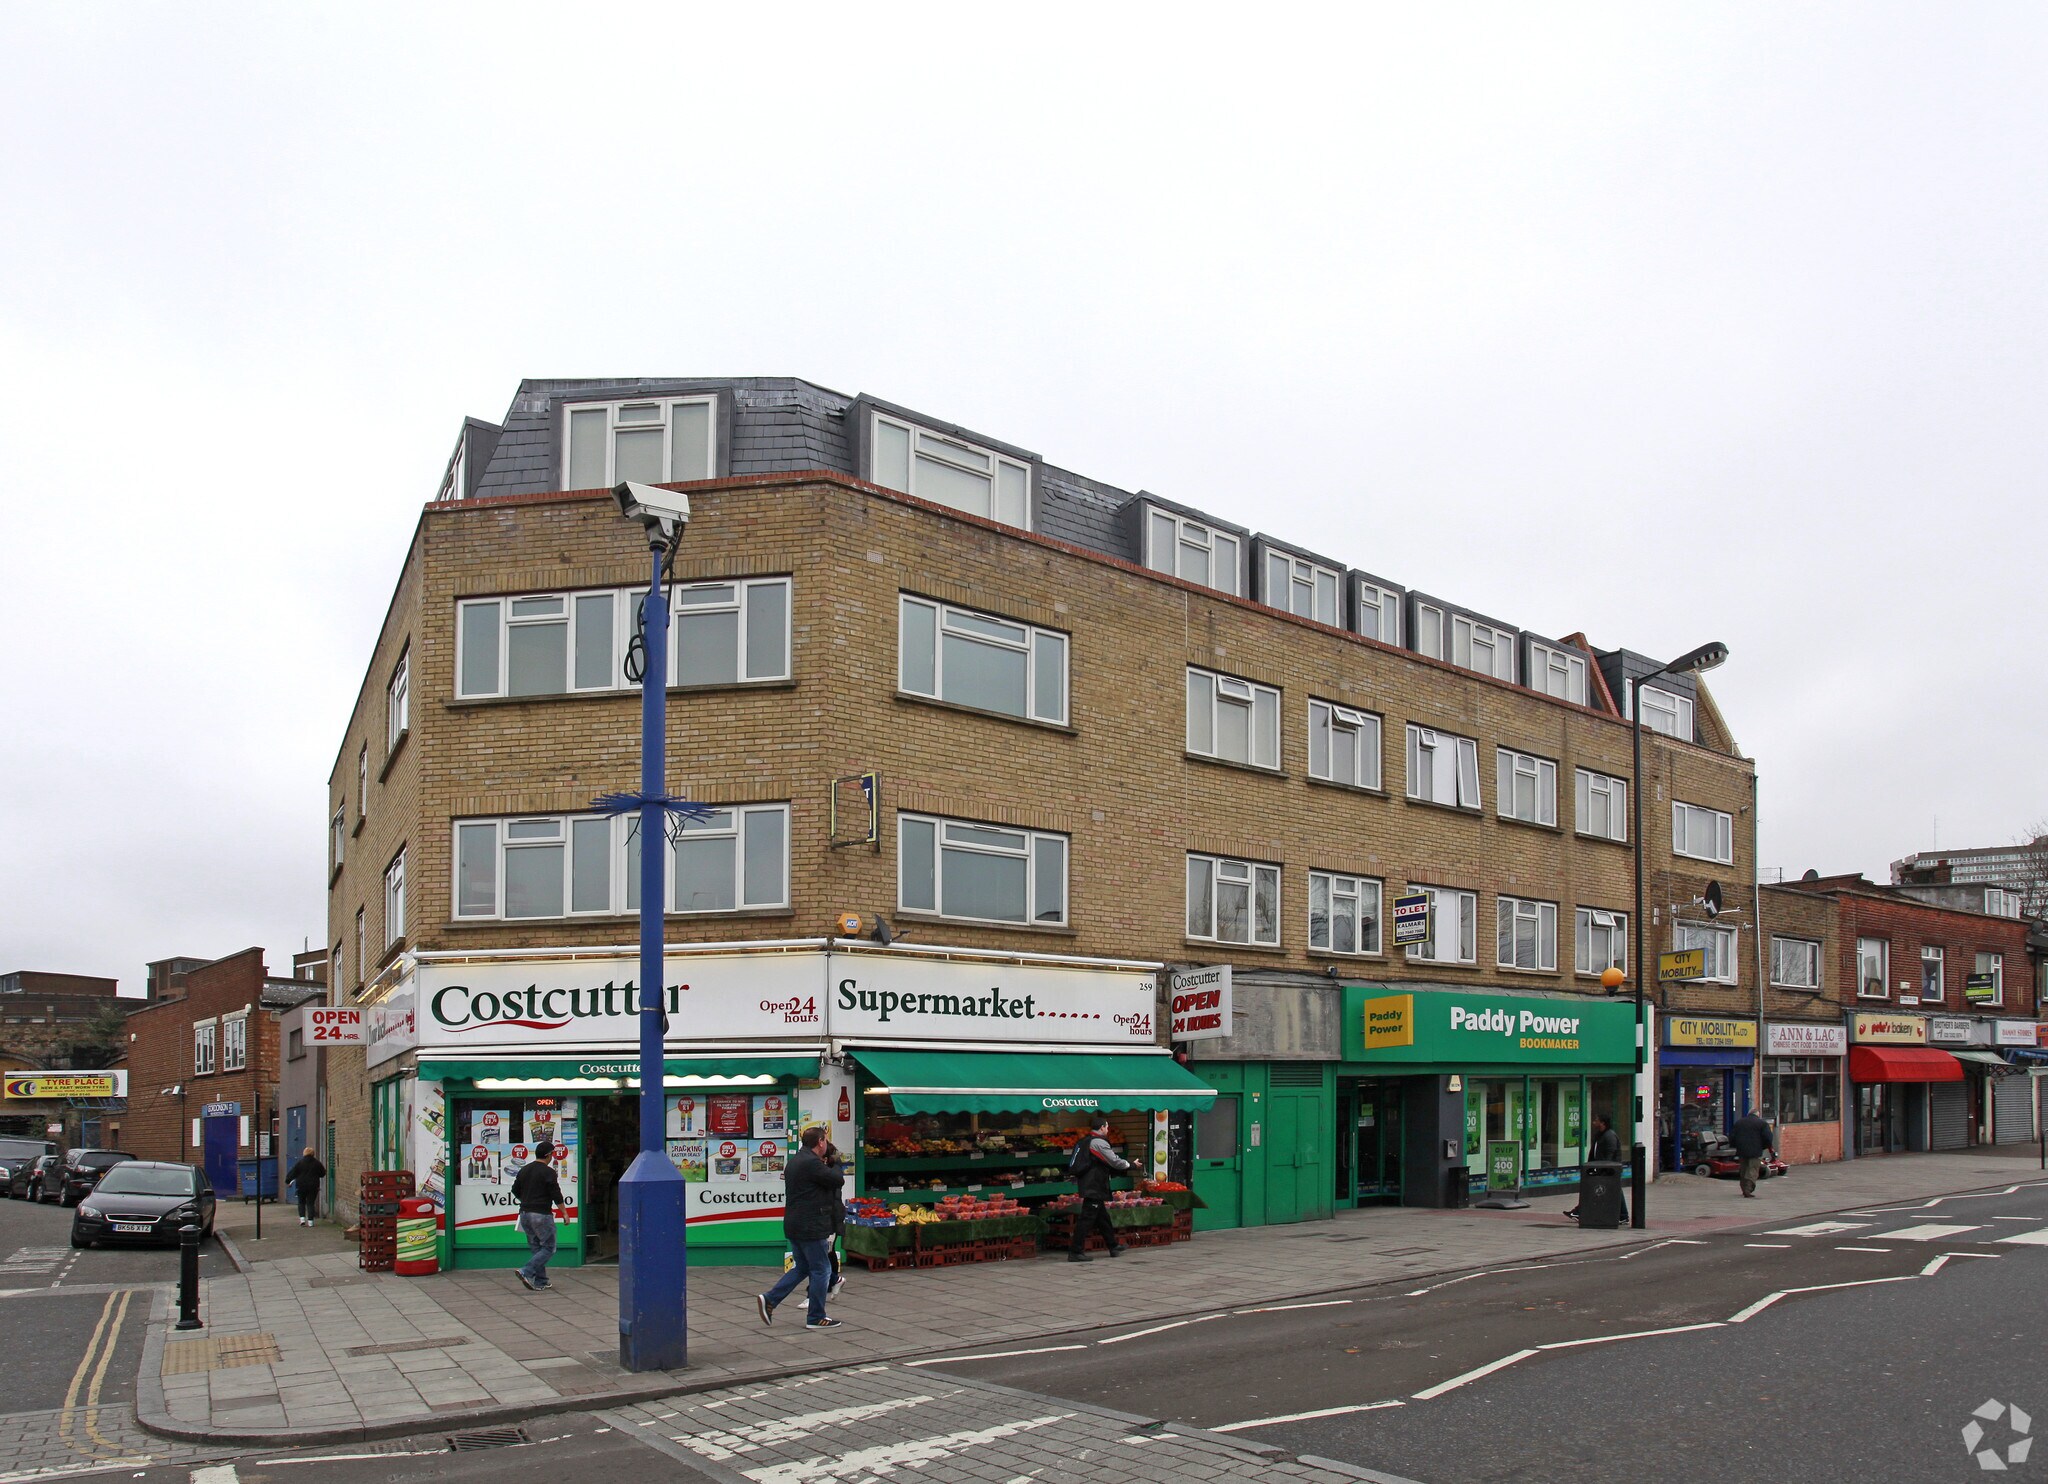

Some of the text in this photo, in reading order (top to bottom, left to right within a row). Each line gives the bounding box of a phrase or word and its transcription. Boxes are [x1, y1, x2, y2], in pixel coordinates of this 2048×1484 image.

[1395, 904, 1427, 916] TO LET
[1674, 953, 1692, 964] CITY
[1660, 966, 1697, 979] MOBILITY
[1139, 982, 1153, 991] 259
[1173, 972, 1221, 990] Costcutter
[431, 979, 690, 1026] Costcuttr
[760, 996, 817, 1014] Open 24
[1172, 989, 1222, 1014] OPEN
[312, 1010, 361, 1024] OPEN
[784, 1012, 819, 1023] hours
[1113, 1012, 1151, 1028] Open 24
[1172, 1012, 1222, 1033] 24 HOURS
[1369, 1010, 1403, 1022] Paddy
[1450, 1006, 1580, 1036] Paddy Power
[313, 1026, 342, 1040] 24
[1129, 1027, 1153, 1035] hours
[1369, 1023, 1403, 1035] Power
[1680, 1021, 1698, 1034] CITY
[1700, 1022, 1738, 1036] MOBILITY
[1779, 1027, 1835, 1041] ANN & LAC
[1871, 1021, 1914, 1036] pete's bakery
[1519, 1038, 1580, 1049] BOOKMAKER
[579, 1063, 641, 1075] Costcutte
[1494, 1161, 1513, 1169] 400
[482, 1191, 520, 1206] Welc
[699, 1189, 786, 1204] Costcutter
